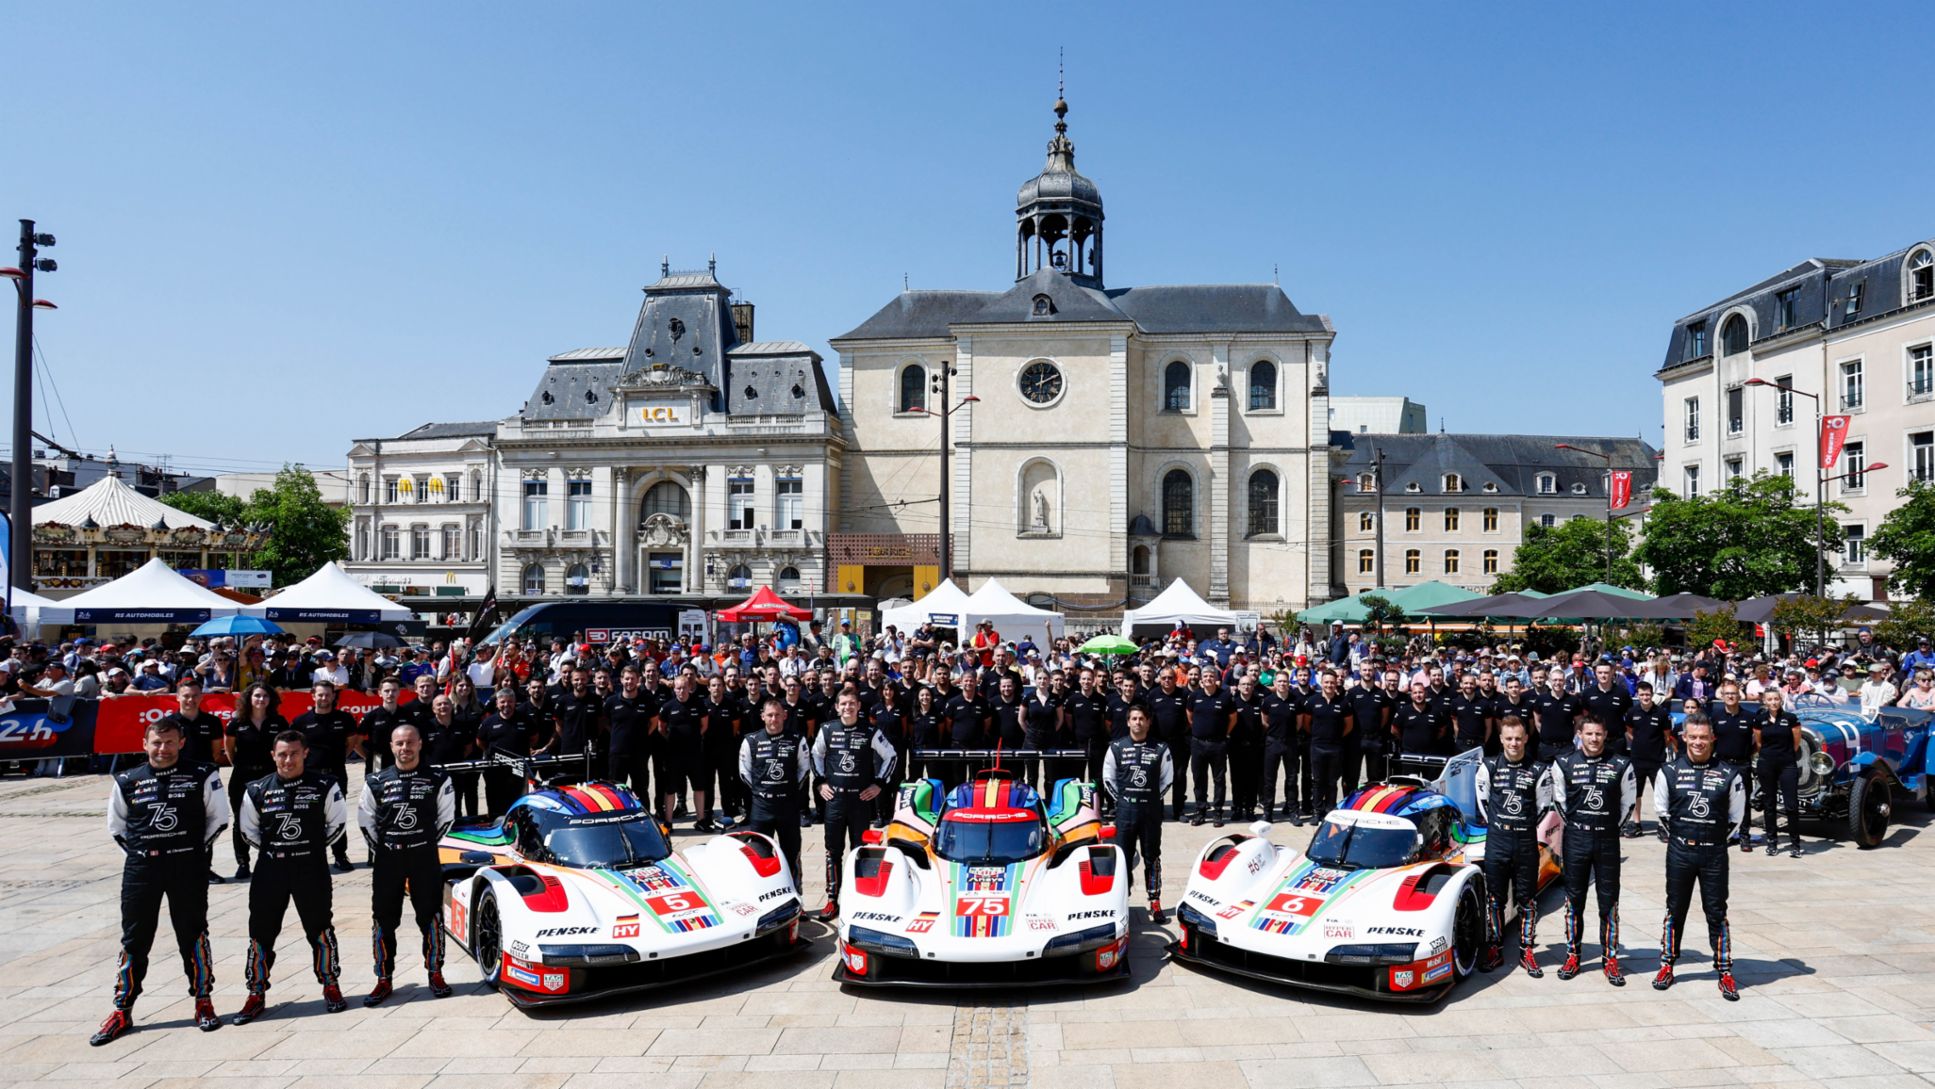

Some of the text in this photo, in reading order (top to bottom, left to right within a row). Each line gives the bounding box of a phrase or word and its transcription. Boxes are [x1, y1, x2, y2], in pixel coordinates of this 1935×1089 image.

[642, 408, 678, 422] LCL
[0, 718, 52, 742] 24h
[838, 750, 855, 772] 75
[766, 759, 784, 780] 75
[1130, 766, 1146, 787] 75
[136, 778, 157, 786] Ansys
[1502, 790, 1522, 815] 75
[1582, 785, 1604, 810] 75
[1687, 791, 1709, 817] 75
[148, 803, 178, 831] 75
[393, 802, 417, 829] 75
[570, 812, 648, 825] PORSCHE
[275, 813, 302, 840] 75
[759, 886, 792, 902] PENSKE
[1188, 890, 1221, 906] PENSKE
[662, 895, 690, 910] 5
[962, 898, 1004, 914] 75
[1282, 897, 1306, 912] 6
[852, 912, 903, 922] PENSKE
[1067, 910, 1116, 920] PENSKE
[536, 927, 600, 938] PENSKE
[614, 924, 638, 936] HY
[1367, 926, 1426, 938] PENSKE
